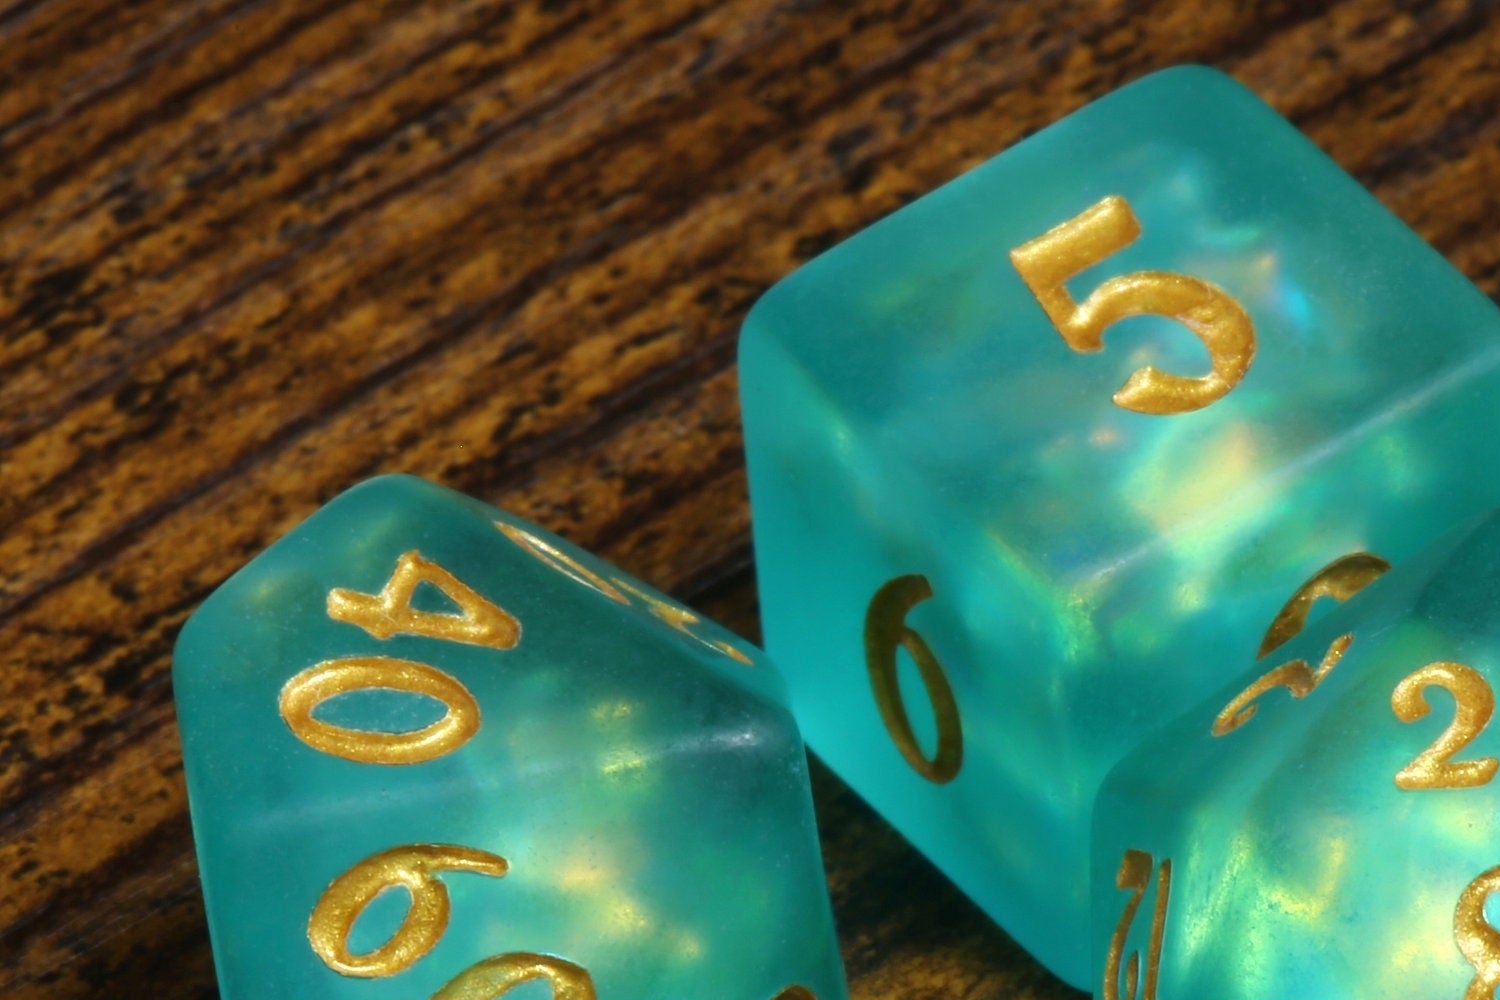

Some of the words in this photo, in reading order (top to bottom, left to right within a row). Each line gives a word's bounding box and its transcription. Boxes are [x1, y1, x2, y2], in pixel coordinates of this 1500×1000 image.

[1010, 195, 1257, 416] 5
[279, 550, 522, 766] 40
[864, 573, 963, 785] 6
